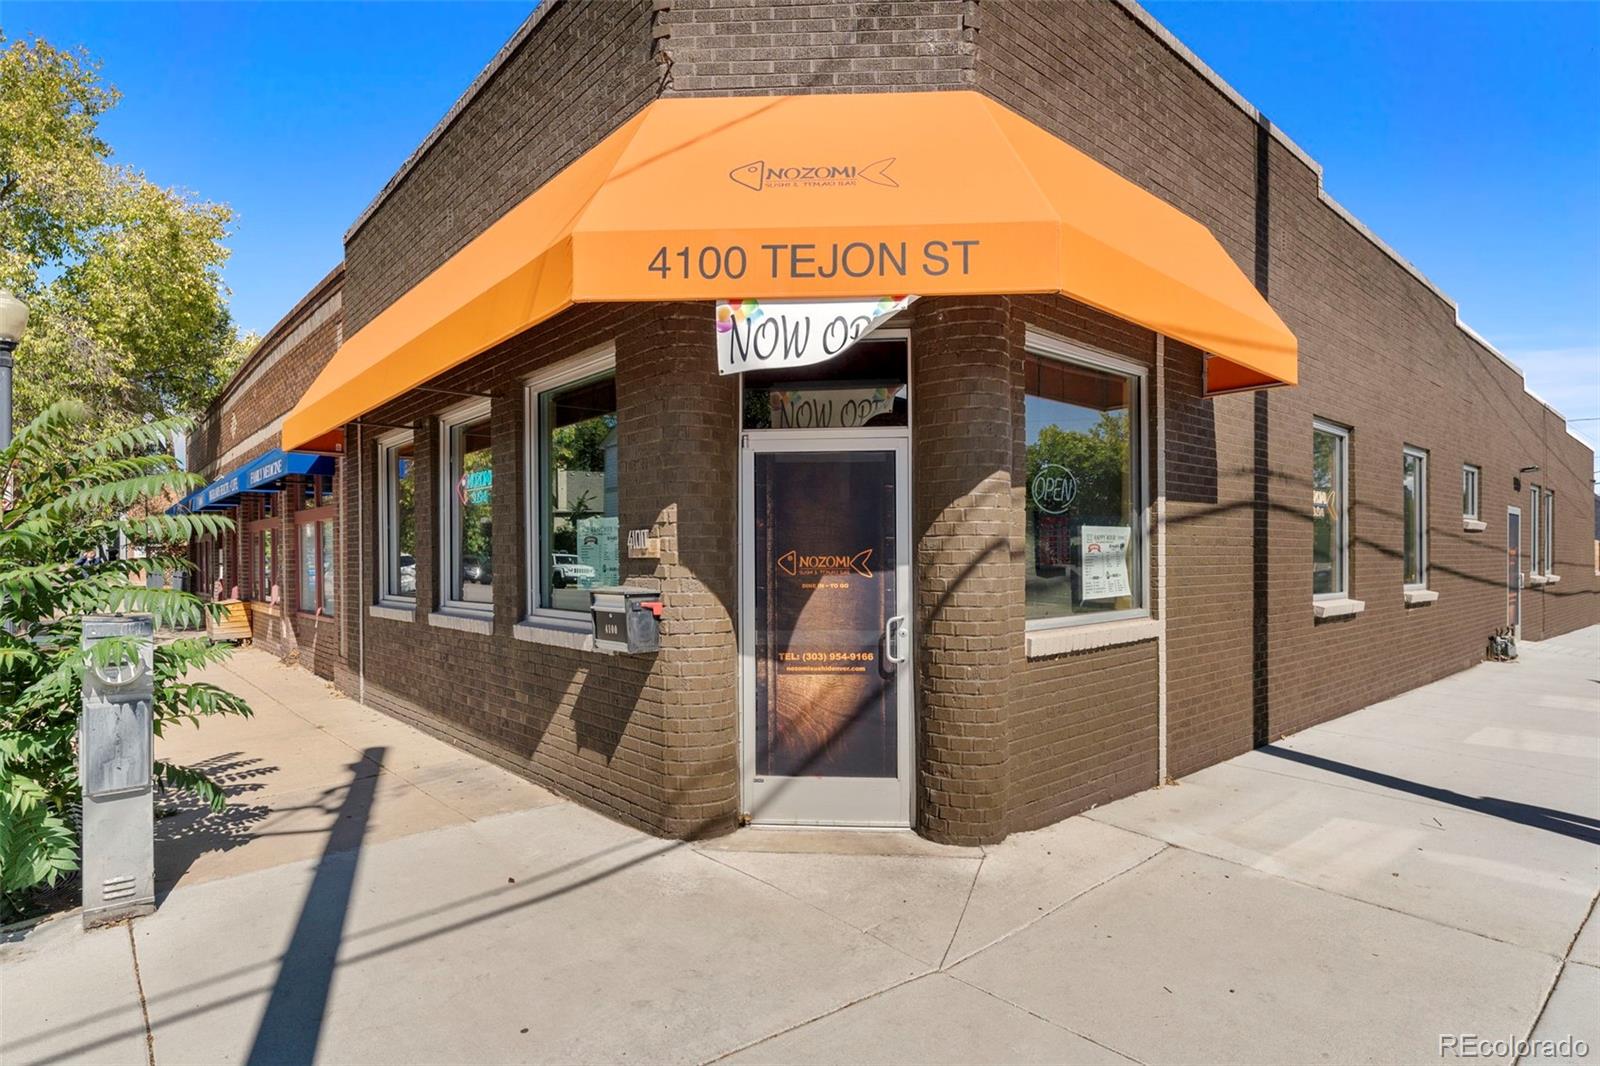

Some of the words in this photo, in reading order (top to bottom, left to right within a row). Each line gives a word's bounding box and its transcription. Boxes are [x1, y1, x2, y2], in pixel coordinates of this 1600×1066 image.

[766, 166, 857, 180] NOZOMI
[648, 246, 748, 280] 4100
[761, 242, 907, 278] TEJON
[922, 240, 980, 276] ST
[730, 314, 810, 364] NOW
[823, 316, 871, 355] OP
[780, 399, 832, 428] NOW
[1034, 476, 1073, 501] OPEN
[627, 529, 650, 549] 4100
[800, 556, 850, 568] NOZOMI
[605, 624, 618, 635] 4100
[779, 652, 800, 661] TEL:
[802, 652, 827, 662] (303)
[829, 652, 874, 661] 954-9166
